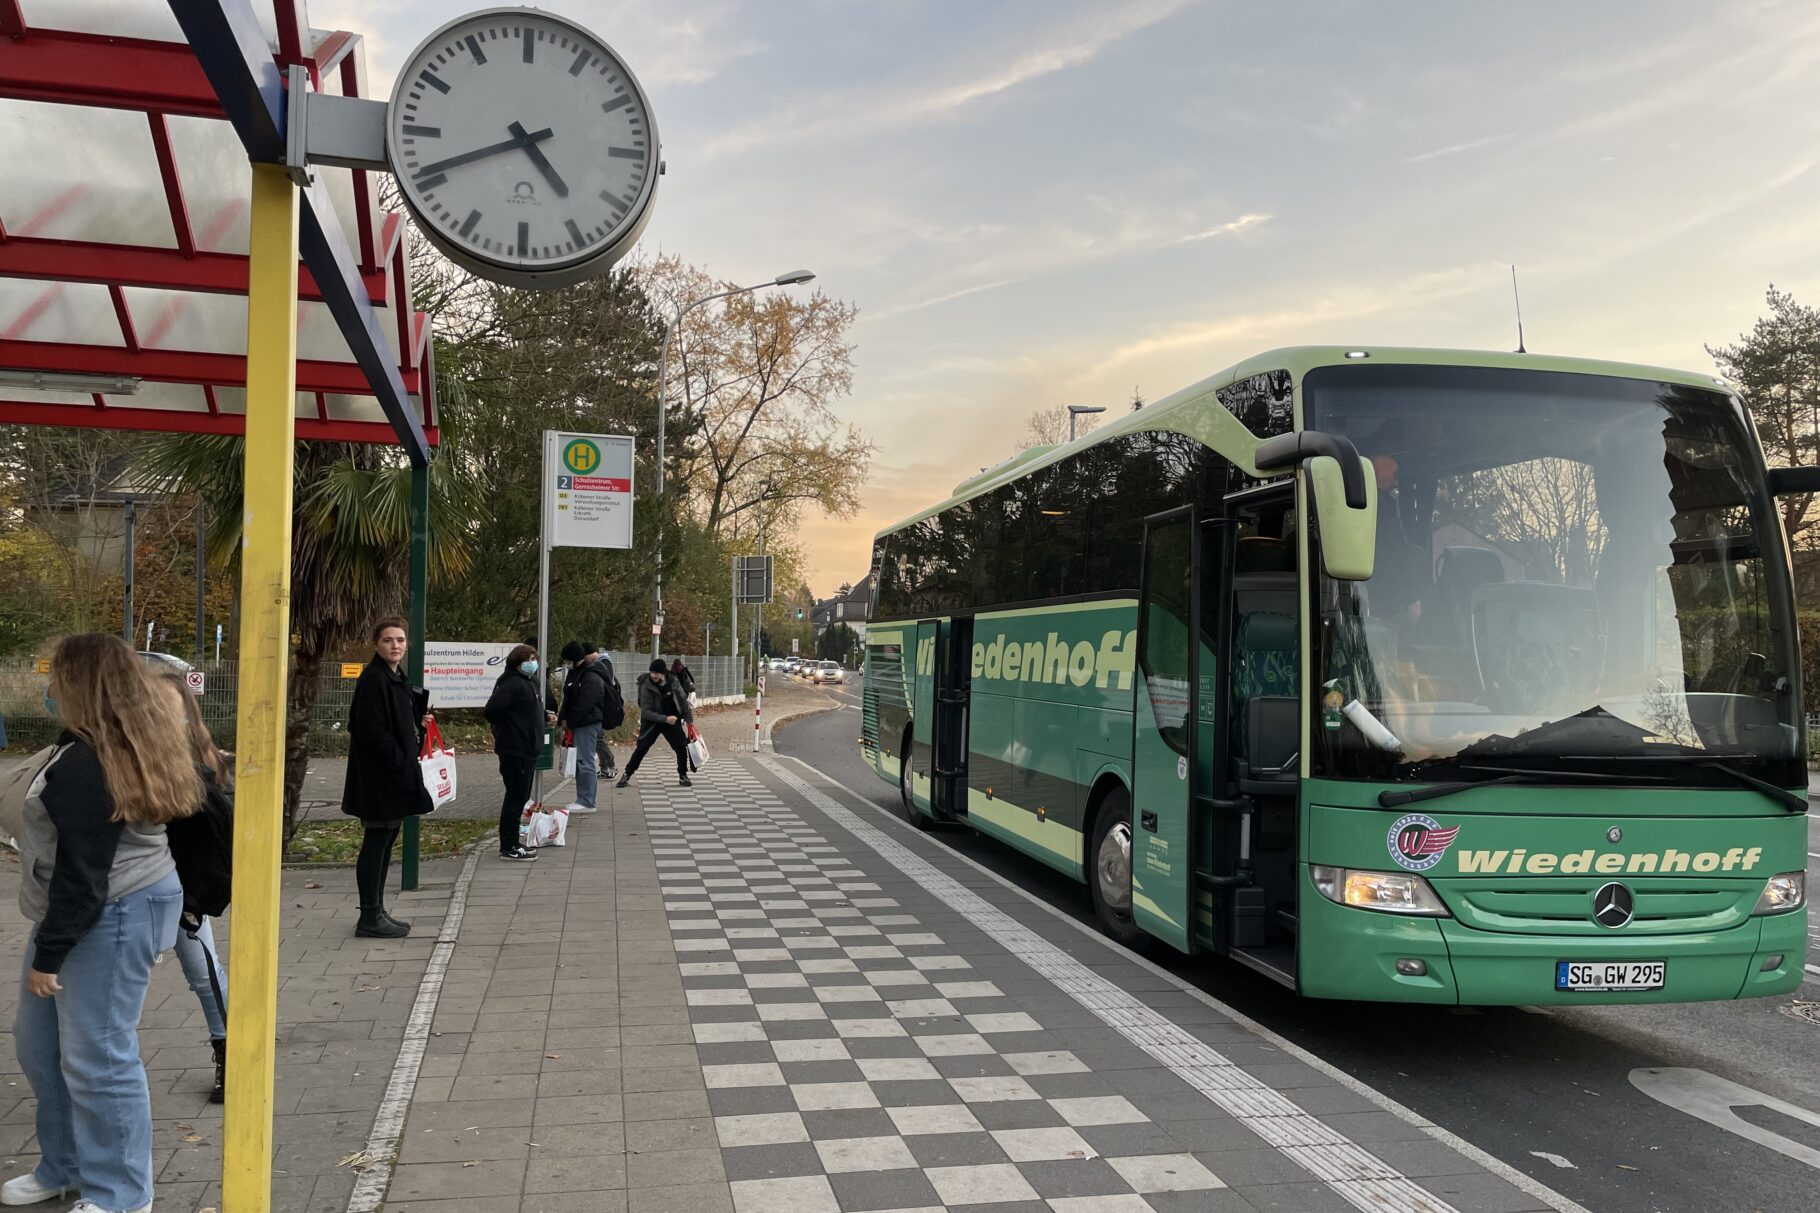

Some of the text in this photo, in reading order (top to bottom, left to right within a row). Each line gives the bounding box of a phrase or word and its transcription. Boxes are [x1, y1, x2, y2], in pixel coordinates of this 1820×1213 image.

[574, 446, 590, 467] H
[561, 477, 568, 488] 2
[574, 477, 613, 485] Schulzentrum,
[430, 667, 484, 675] Haupteingang
[1396, 816, 1417, 828] 1924
[1457, 847, 1763, 874] Wiedenhoff
[1561, 965, 1663, 984] D SG GW 295
